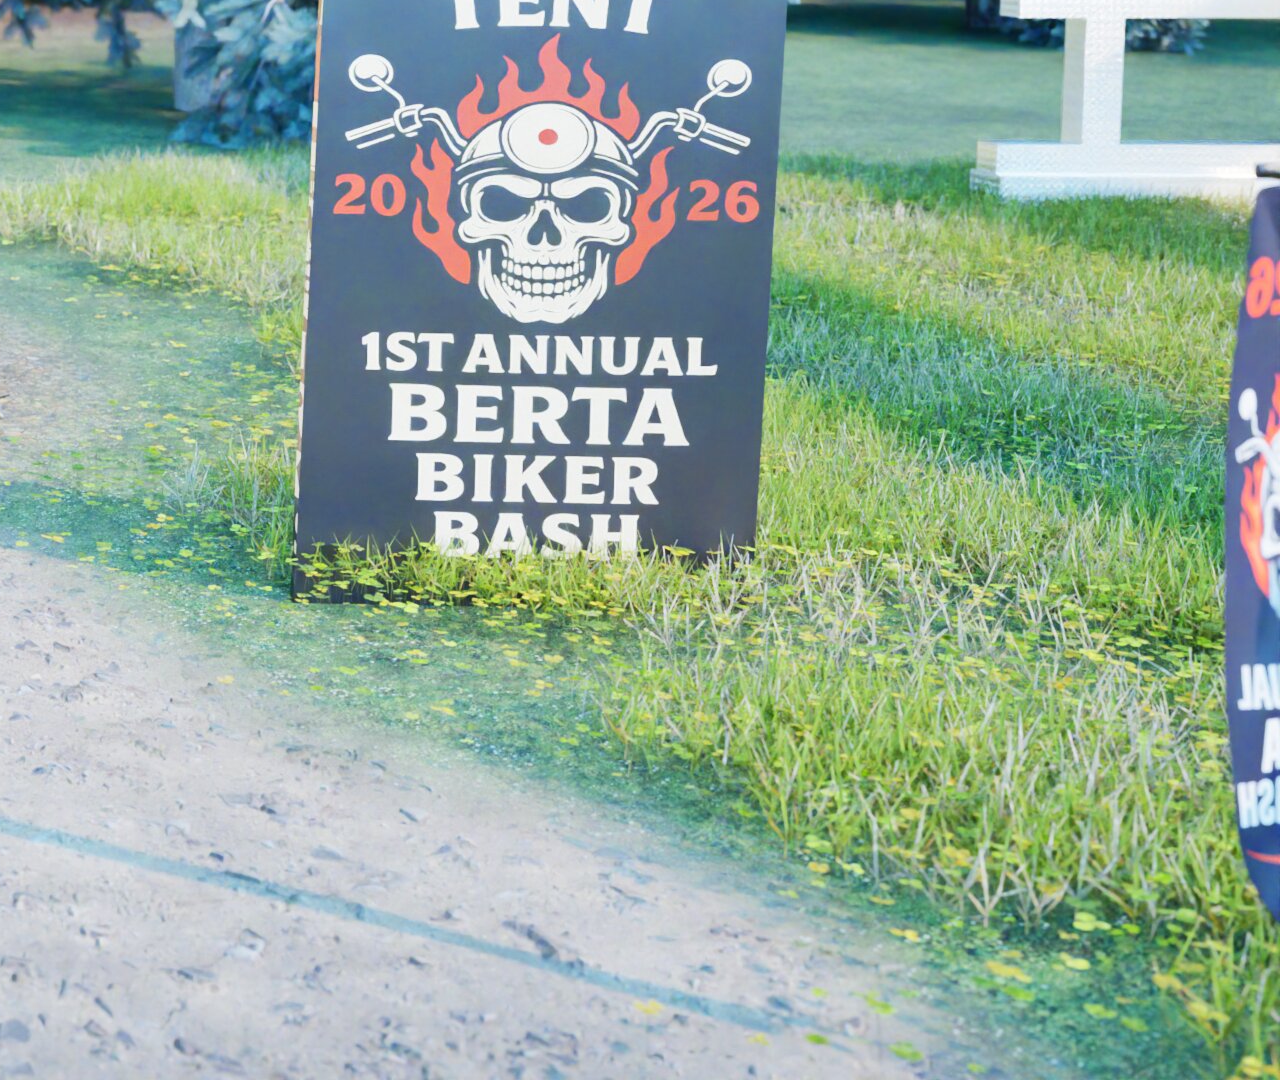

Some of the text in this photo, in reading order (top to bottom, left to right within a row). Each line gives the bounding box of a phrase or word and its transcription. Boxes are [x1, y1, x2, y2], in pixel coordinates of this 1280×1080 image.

[332, 173, 761, 223] 20 26
[361, 331, 719, 377] 1ST ANNUAL
[387, 382, 690, 447] BERTA
[414, 452, 660, 506] BIKER
[433, 510, 641, 562] BASH
